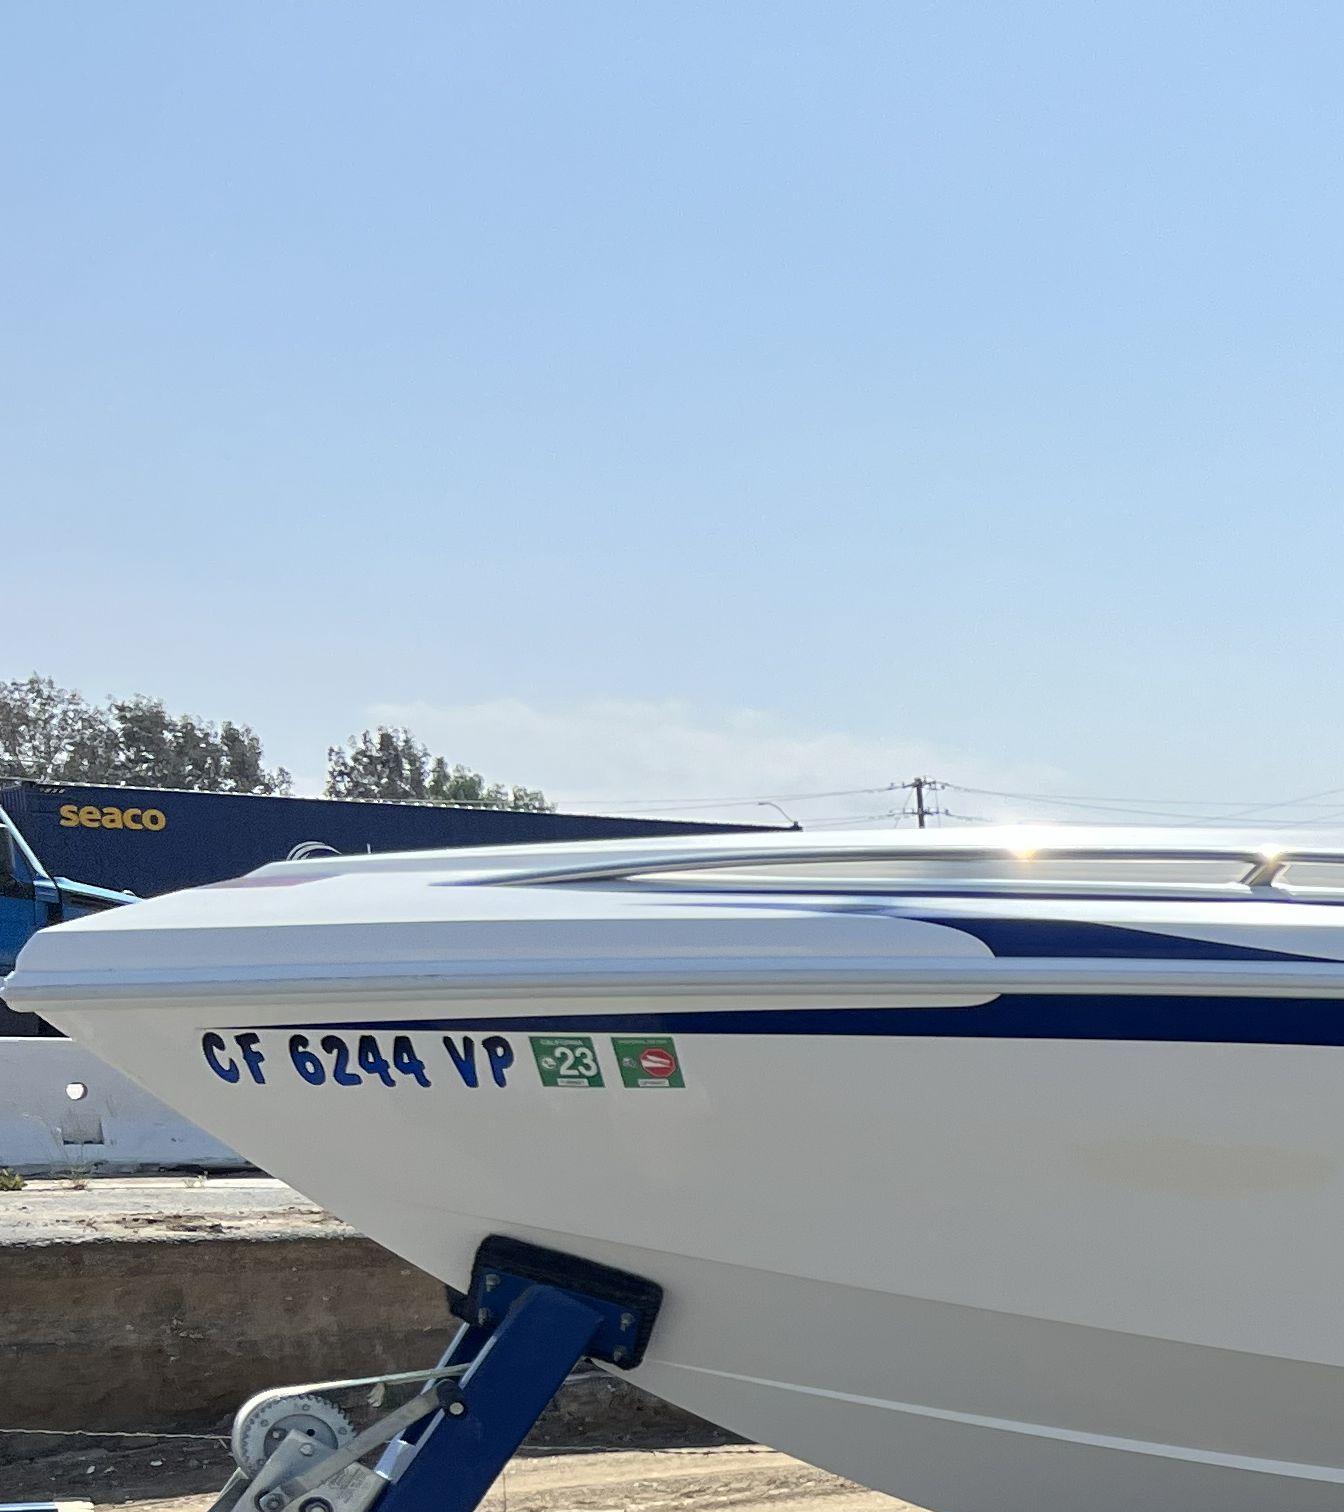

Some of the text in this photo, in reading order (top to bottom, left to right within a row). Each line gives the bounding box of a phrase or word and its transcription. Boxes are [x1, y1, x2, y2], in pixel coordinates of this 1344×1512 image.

[59, 804, 167, 831] seaco
[202, 1032, 515, 1088] CF 6244 VP
[554, 1046, 598, 1077] 23
